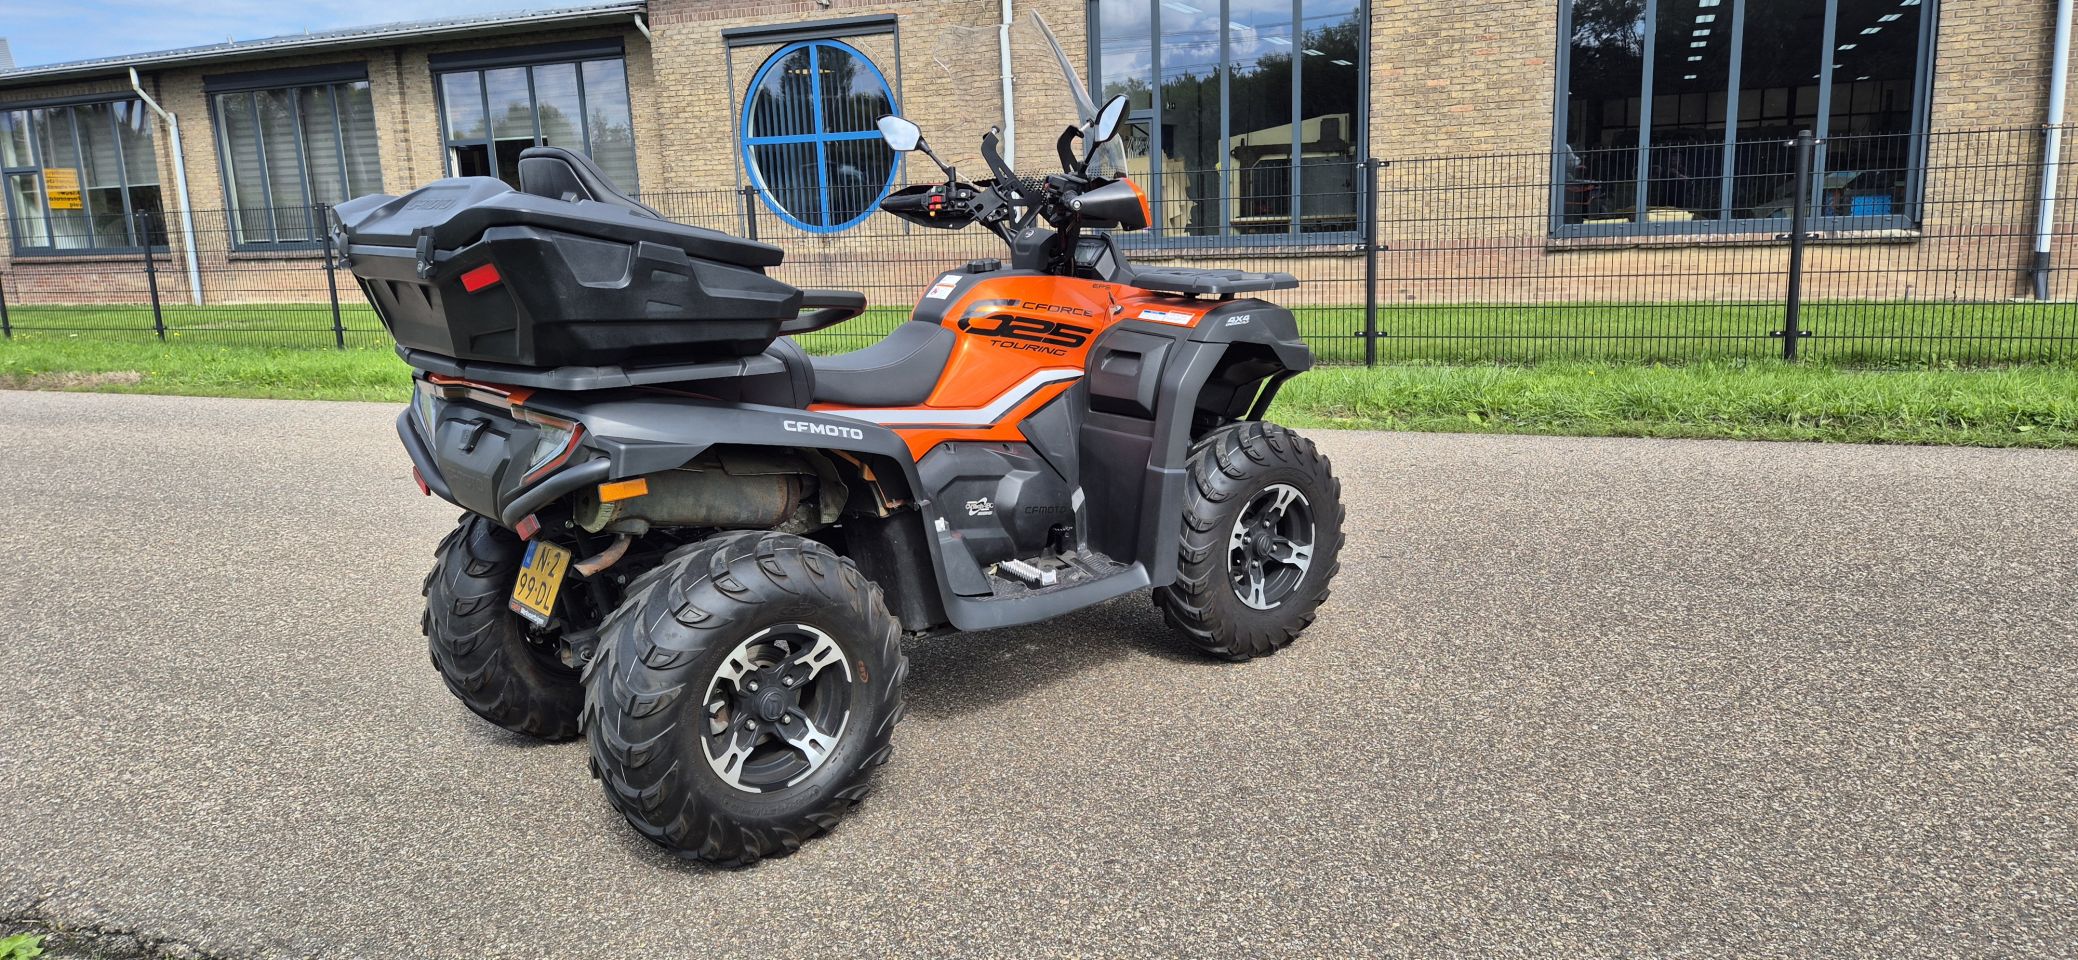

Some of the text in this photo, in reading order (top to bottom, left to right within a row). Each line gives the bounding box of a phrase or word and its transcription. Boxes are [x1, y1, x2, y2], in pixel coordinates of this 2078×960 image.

[1022, 301, 1093, 317] CFORCE
[991, 339, 1068, 357] TOURING
[783, 420, 864, 440] CFMOTO
